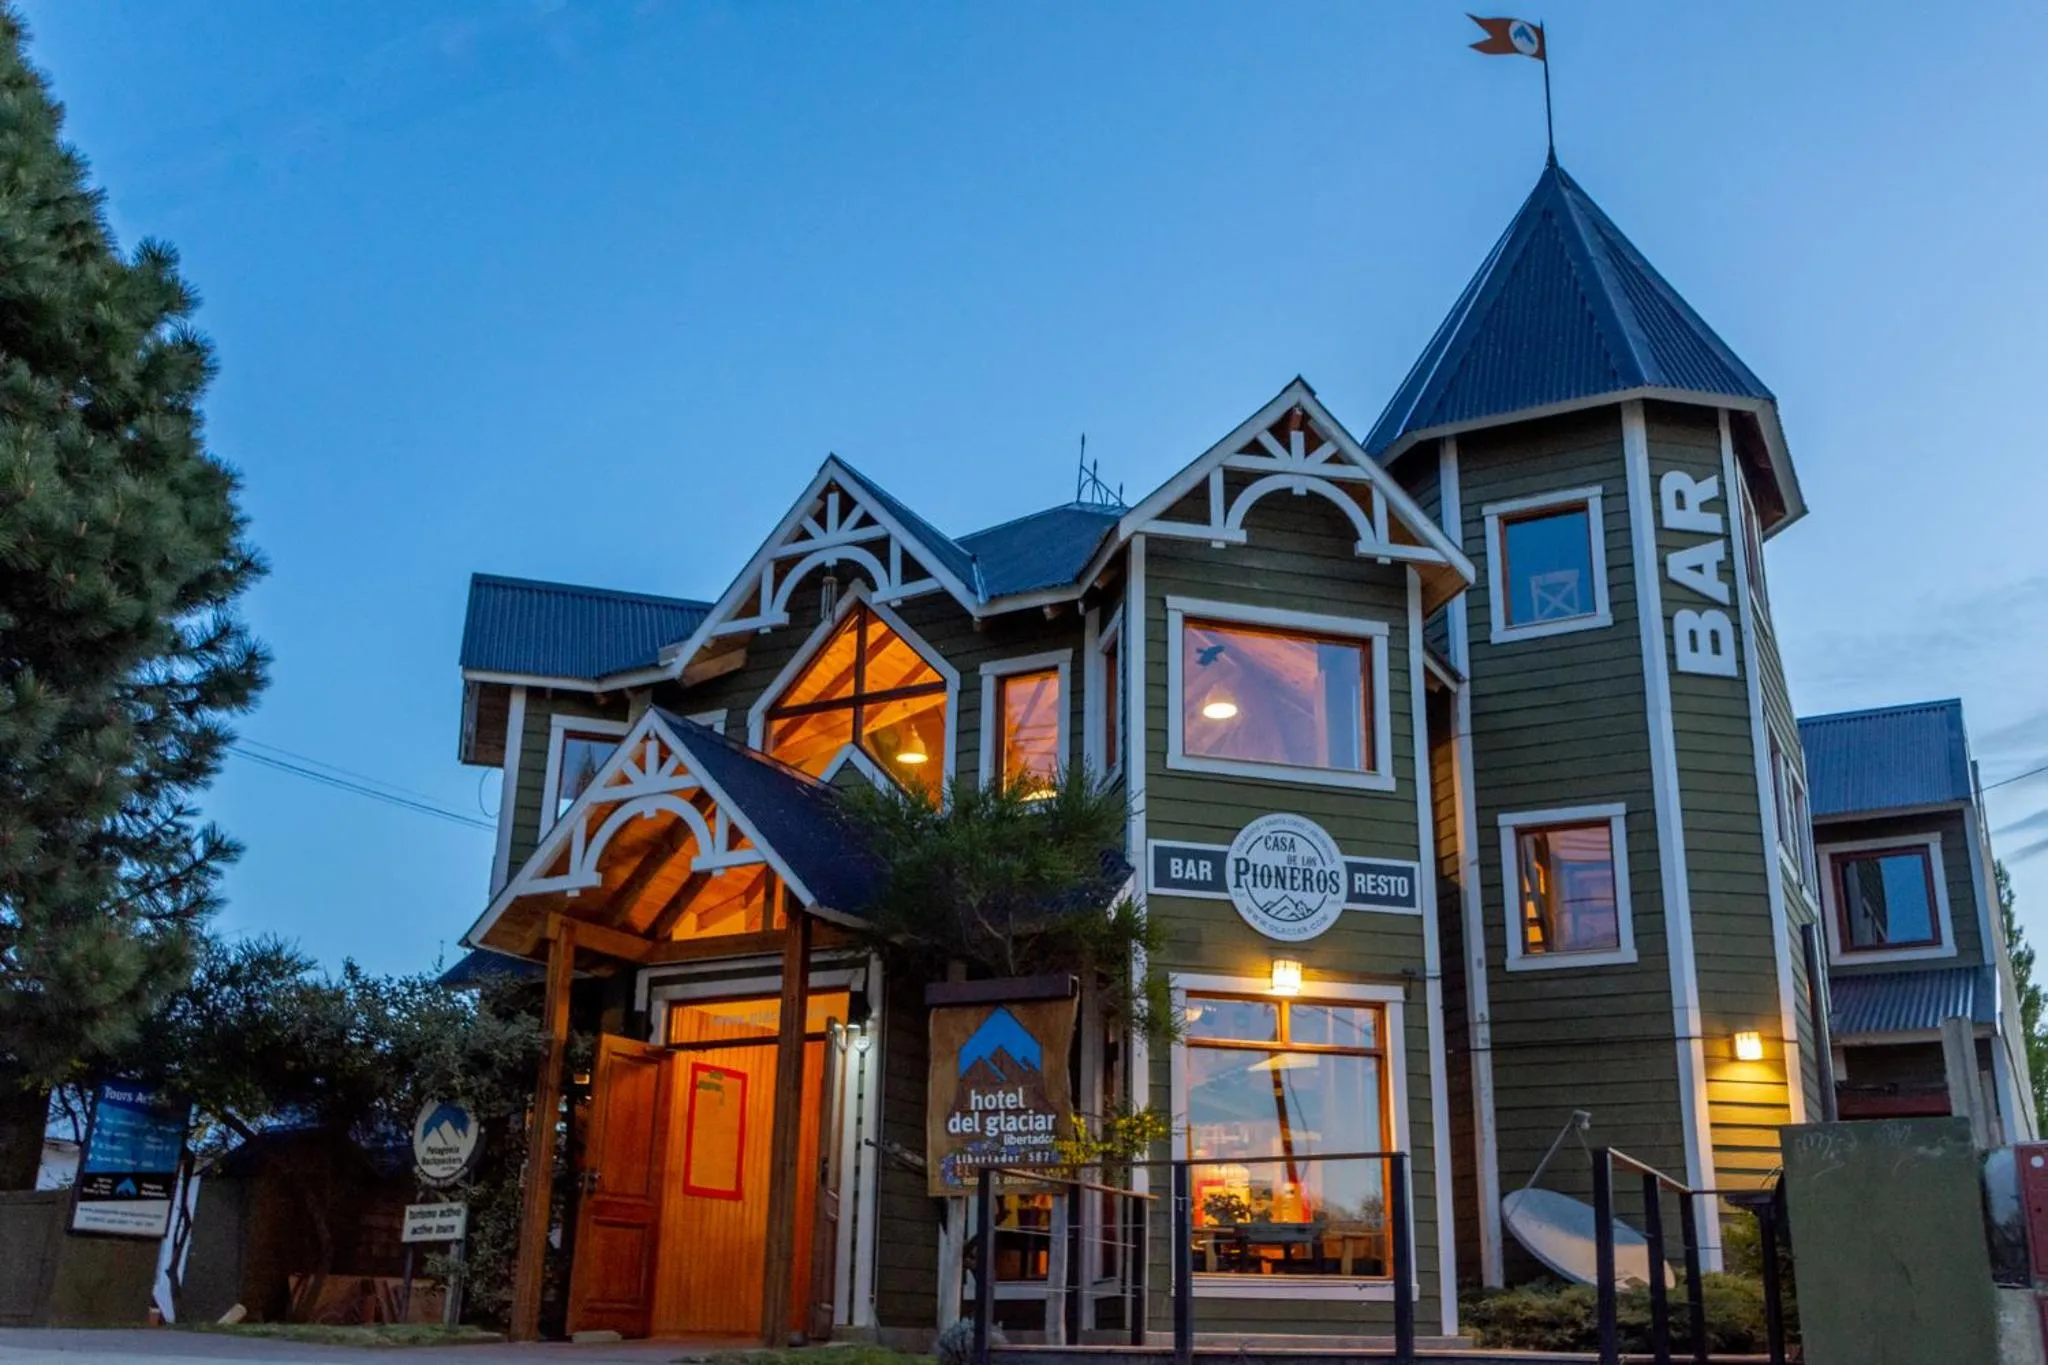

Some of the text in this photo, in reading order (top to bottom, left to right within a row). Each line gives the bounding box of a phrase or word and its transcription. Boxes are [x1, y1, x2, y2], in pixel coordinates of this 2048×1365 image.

[1660, 470, 1738, 678] BAR
[1264, 834, 1296, 853] CASA
[1170, 858, 1212, 881] BAR
[1287, 854, 1317, 868] DE LOS
[1233, 857, 1340, 895] PIONEROS
[1354, 872, 1408, 897] RESTO
[104, 1086, 133, 1102] Tours
[970, 1086, 1025, 1110] hotel
[948, 1109, 1056, 1136] del glaciar
[1004, 1133, 1055, 1145] libertador
